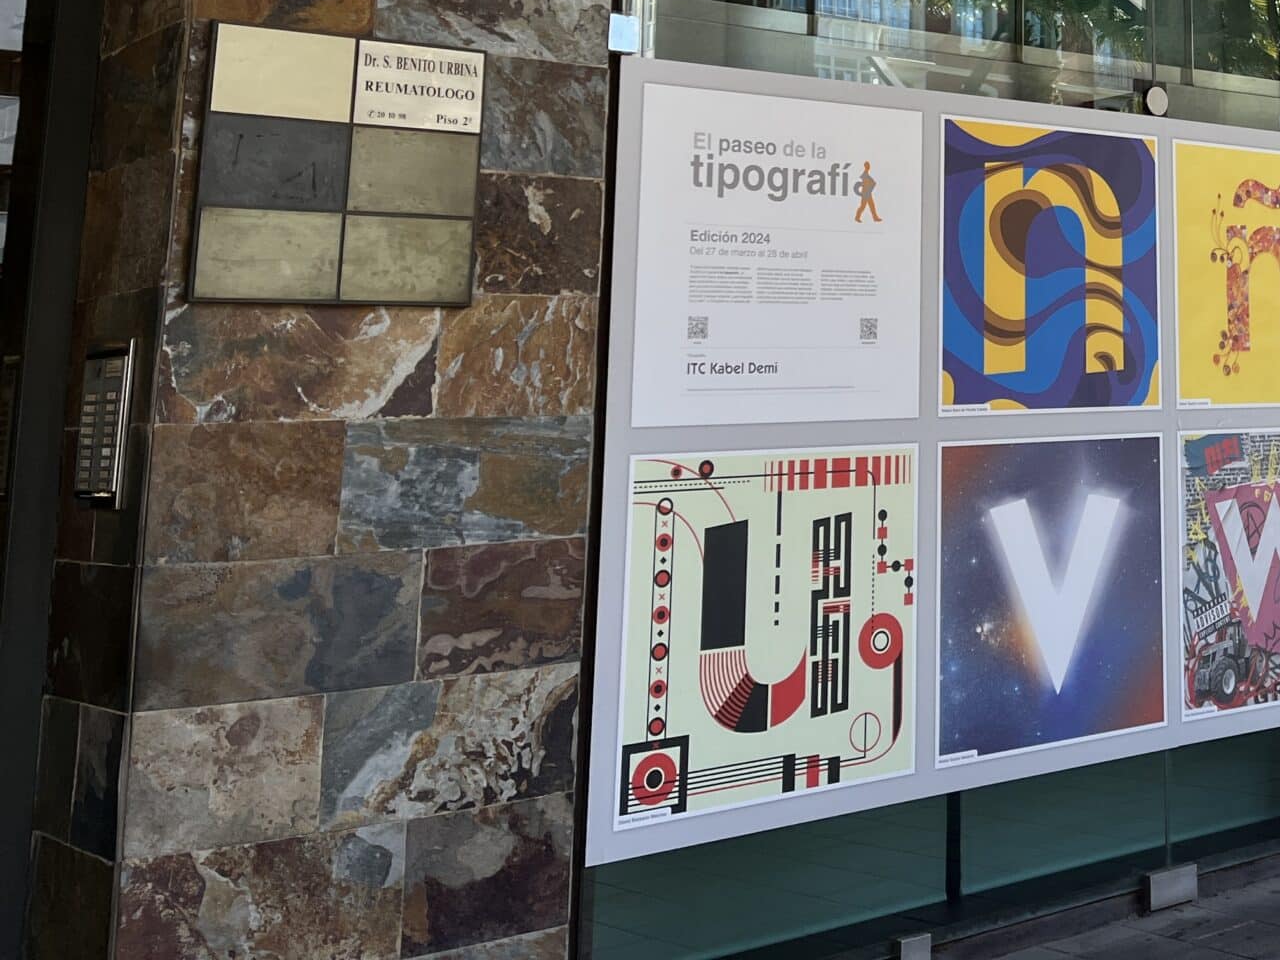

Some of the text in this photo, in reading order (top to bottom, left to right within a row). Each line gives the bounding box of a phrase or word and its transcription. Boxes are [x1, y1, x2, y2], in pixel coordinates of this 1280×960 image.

[364, 53, 479, 78] Dr. S. BENITO URBINA
[365, 80, 476, 101] REUMATOLOGO
[436, 113, 459, 125] Piso
[694, 131, 826, 159] El paseo de la
[690, 229, 771, 245] Edición 2024
[705, 246, 716, 256] 27
[718, 247, 729, 257] de
[731, 248, 757, 258] marzo
[779, 249, 790, 259] de
[984, 161, 1125, 375] n
[686, 361, 779, 376] ITC Kabel Demi
